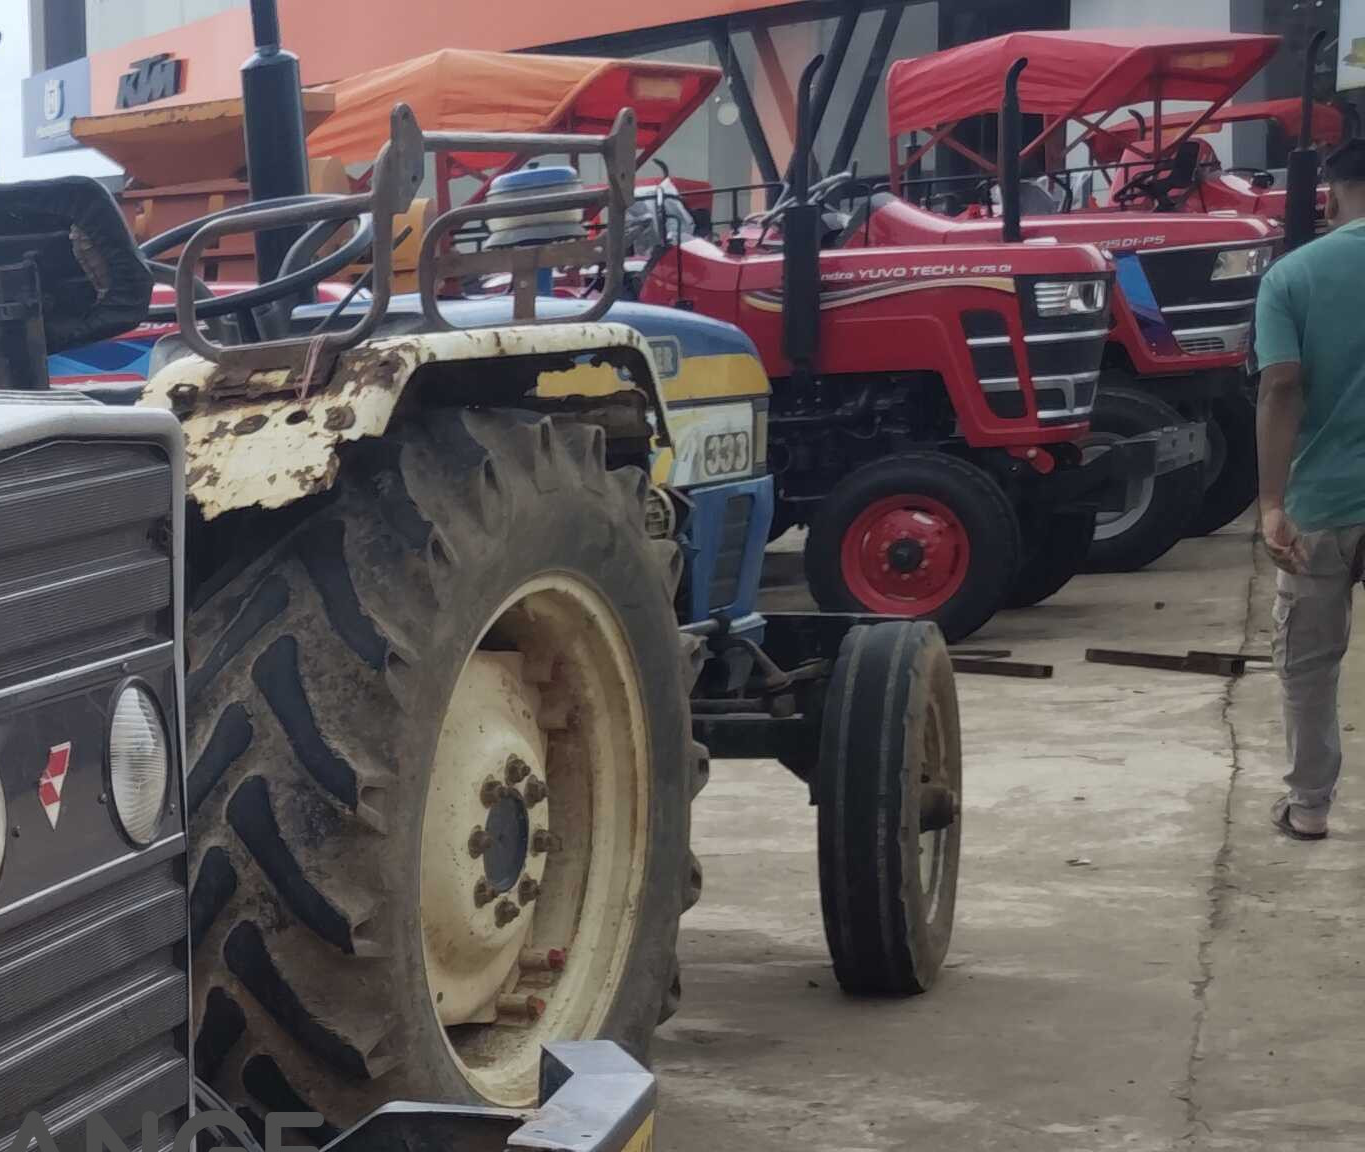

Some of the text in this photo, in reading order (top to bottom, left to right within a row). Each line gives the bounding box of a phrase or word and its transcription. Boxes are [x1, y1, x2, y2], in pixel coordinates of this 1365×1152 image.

[115, 52, 182, 110] KTM
[859, 268, 907, 279] YUVO
[910, 265, 955, 277] TECH
[706, 433, 749, 475] 333
